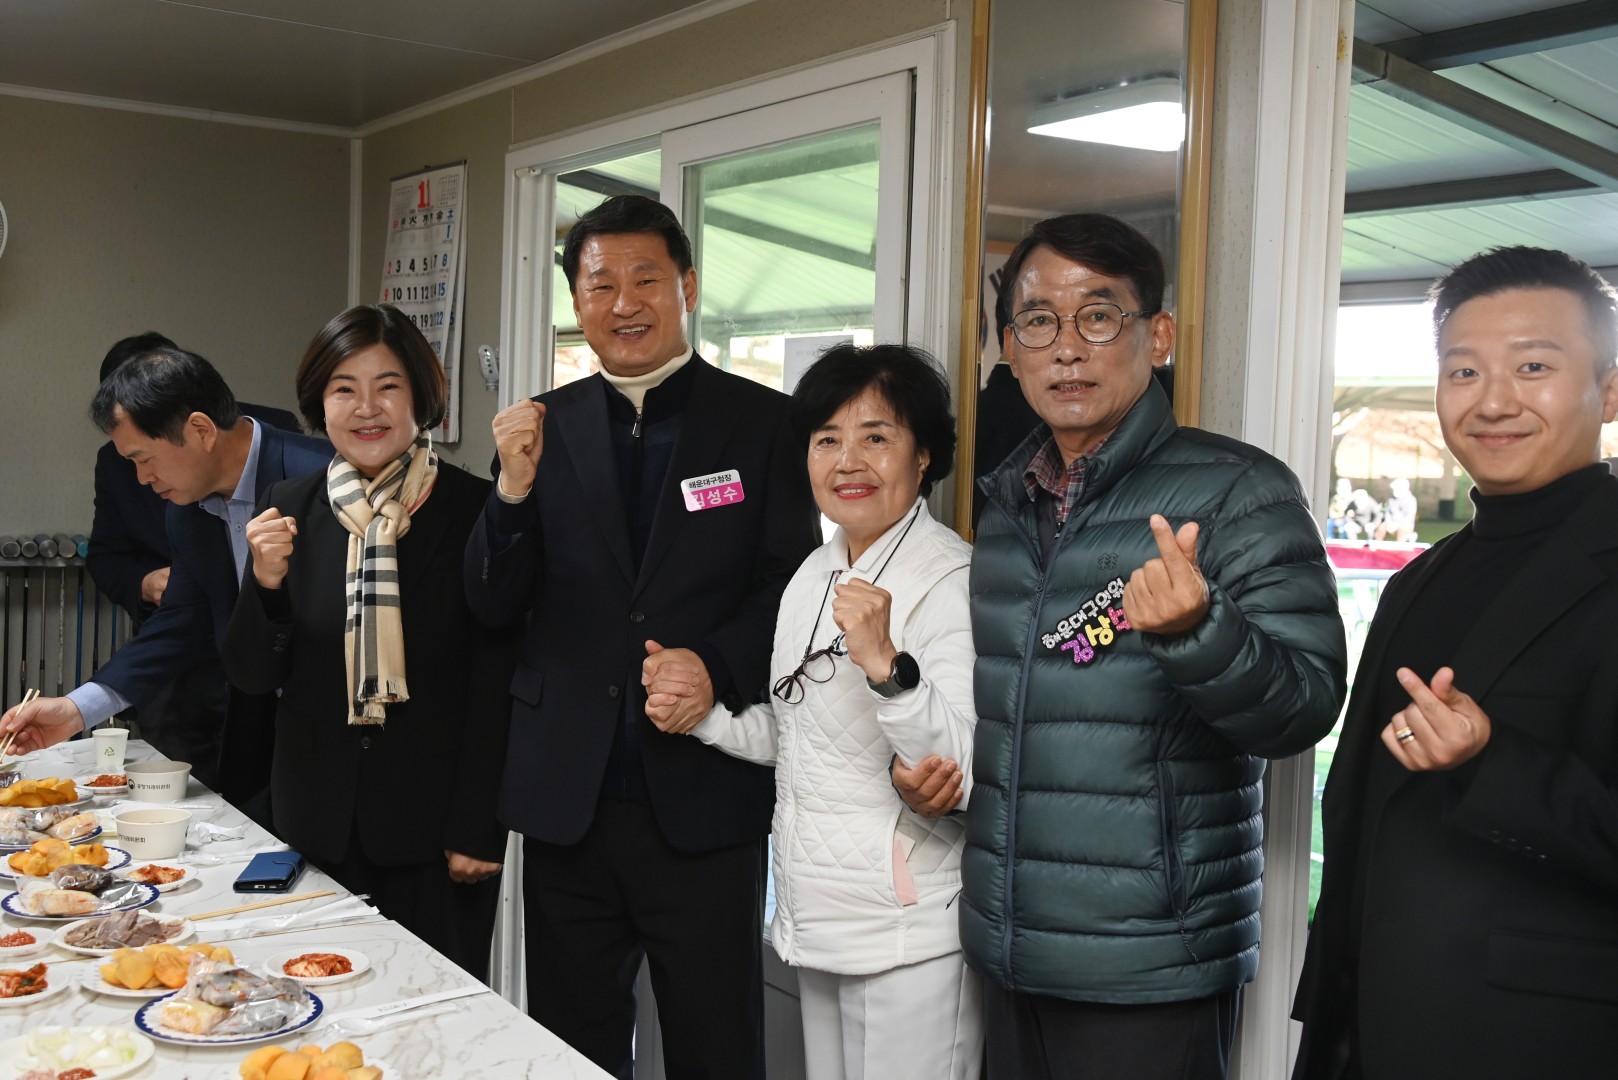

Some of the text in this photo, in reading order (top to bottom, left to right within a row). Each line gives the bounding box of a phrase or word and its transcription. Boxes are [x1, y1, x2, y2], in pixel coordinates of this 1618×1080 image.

[409, 216, 417, 224] 火
[447, 208, 454, 218] 土
[396, 259, 401, 273] 3
[409, 258, 416, 272] 4
[423, 257, 428, 271] 5
[442, 253, 448, 267] 8
[384, 288, 389, 301] 9
[393, 287, 402, 300] 10
[407, 287, 417, 300] 11
[421, 286, 429, 300] 12
[438, 282, 446, 296] 15
[421, 314, 428, 328] 19
[689, 473, 732, 488] 해운대구청장
[692, 486, 738, 507] 김성수
[1041, 577, 1125, 649] 해운대구의원
